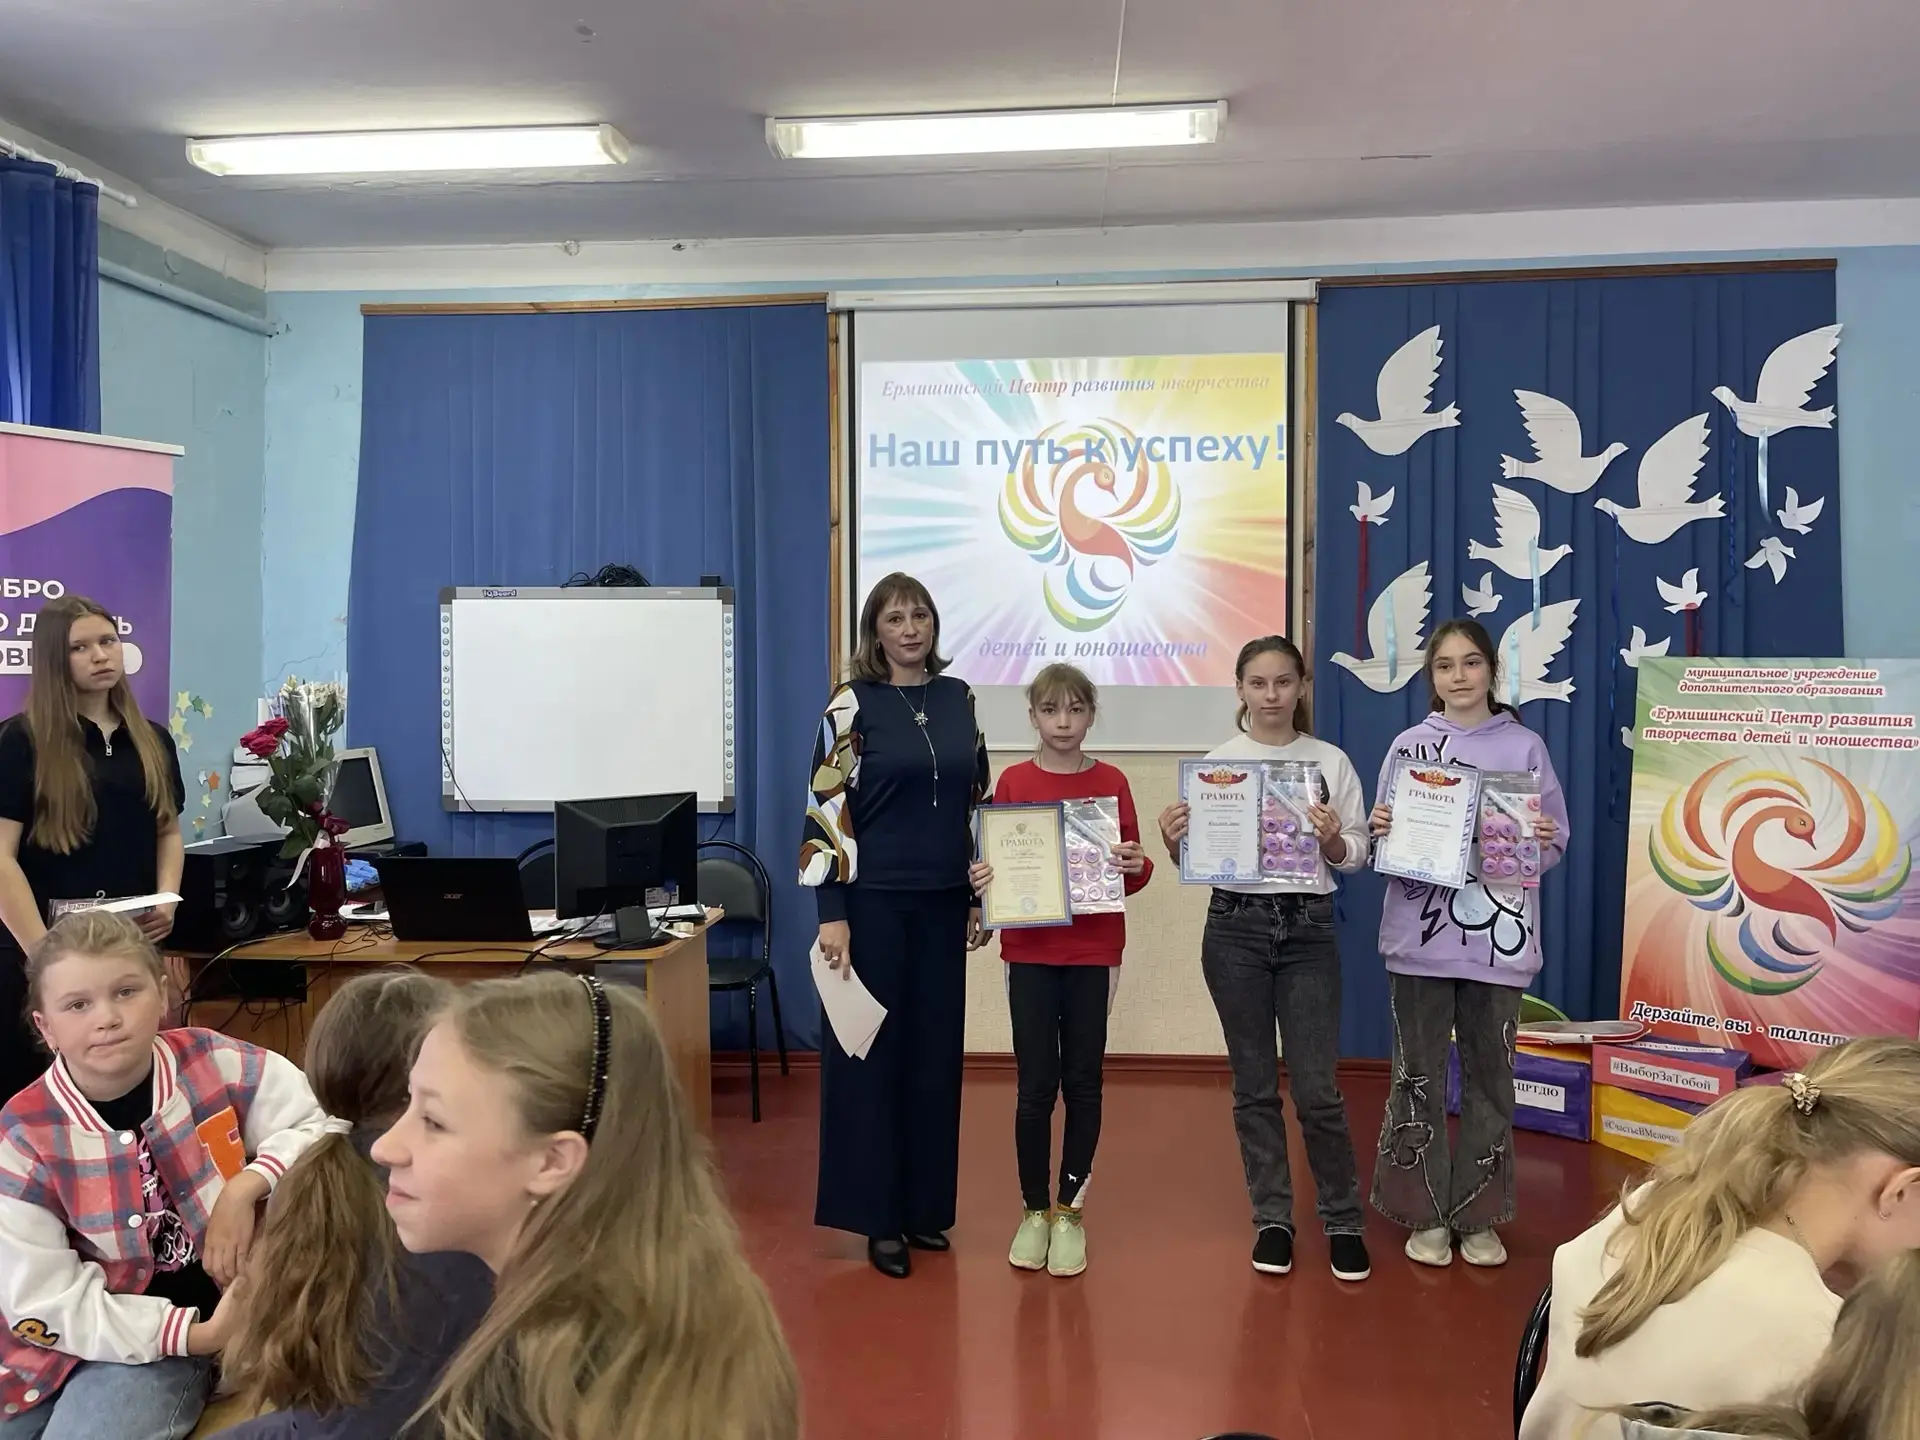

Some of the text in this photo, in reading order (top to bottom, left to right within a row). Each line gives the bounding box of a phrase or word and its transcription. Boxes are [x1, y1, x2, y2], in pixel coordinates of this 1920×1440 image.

[882, 376, 1270, 399] Ермишинский Центр развития творчества
[868, 424, 1286, 474] Наш путь к успеху!
[0, 577, 65, 600] БРО
[979, 637, 1208, 658] детей и юношества
[1686, 667, 1877, 682] муниципальное учреждение
[1679, 681, 1884, 697] дополнительного образования
[1650, 706, 1914, 729] «Ермишинский Центр развития
[1644, 729, 1919, 749] творчества детей и юношества»
[1200, 792, 1245, 801] ГРАМОТА
[1408, 789, 1455, 804] ГРАМОТА
[1000, 838, 1044, 848] ГРАМОТА
[1630, 1002, 1720, 1030] Дерзайте,
[1724, 1019, 1751, 1033] вы
[1769, 1026, 1849, 1046] талант
[1612, 1060, 1712, 1091] #ВыборЗаТобой
